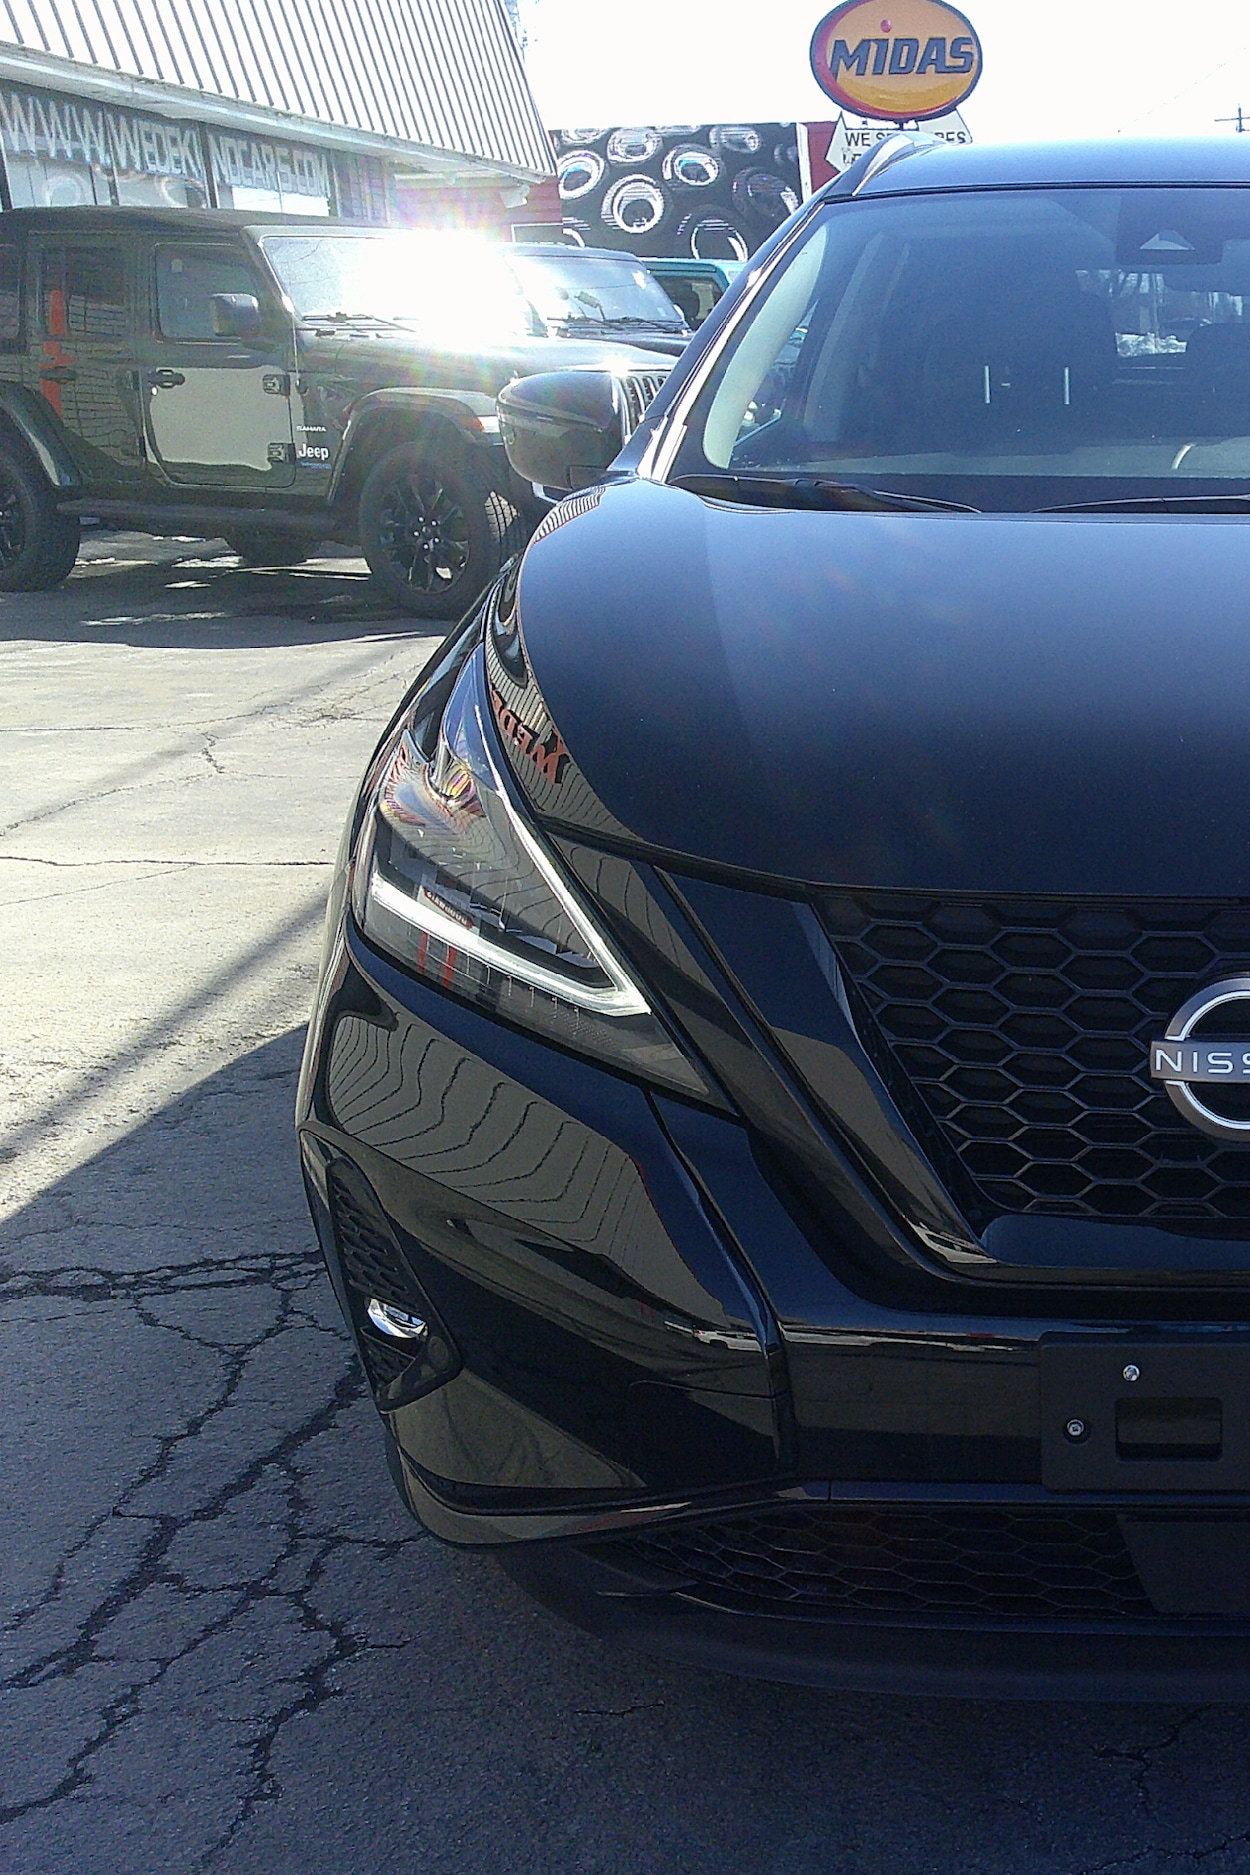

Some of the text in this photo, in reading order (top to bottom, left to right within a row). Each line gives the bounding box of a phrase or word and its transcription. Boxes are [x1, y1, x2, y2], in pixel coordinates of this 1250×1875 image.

[828, 37, 975, 81] MIDAS
[845, 132, 871, 147] WE
[298, 443, 329, 461] Jeep
